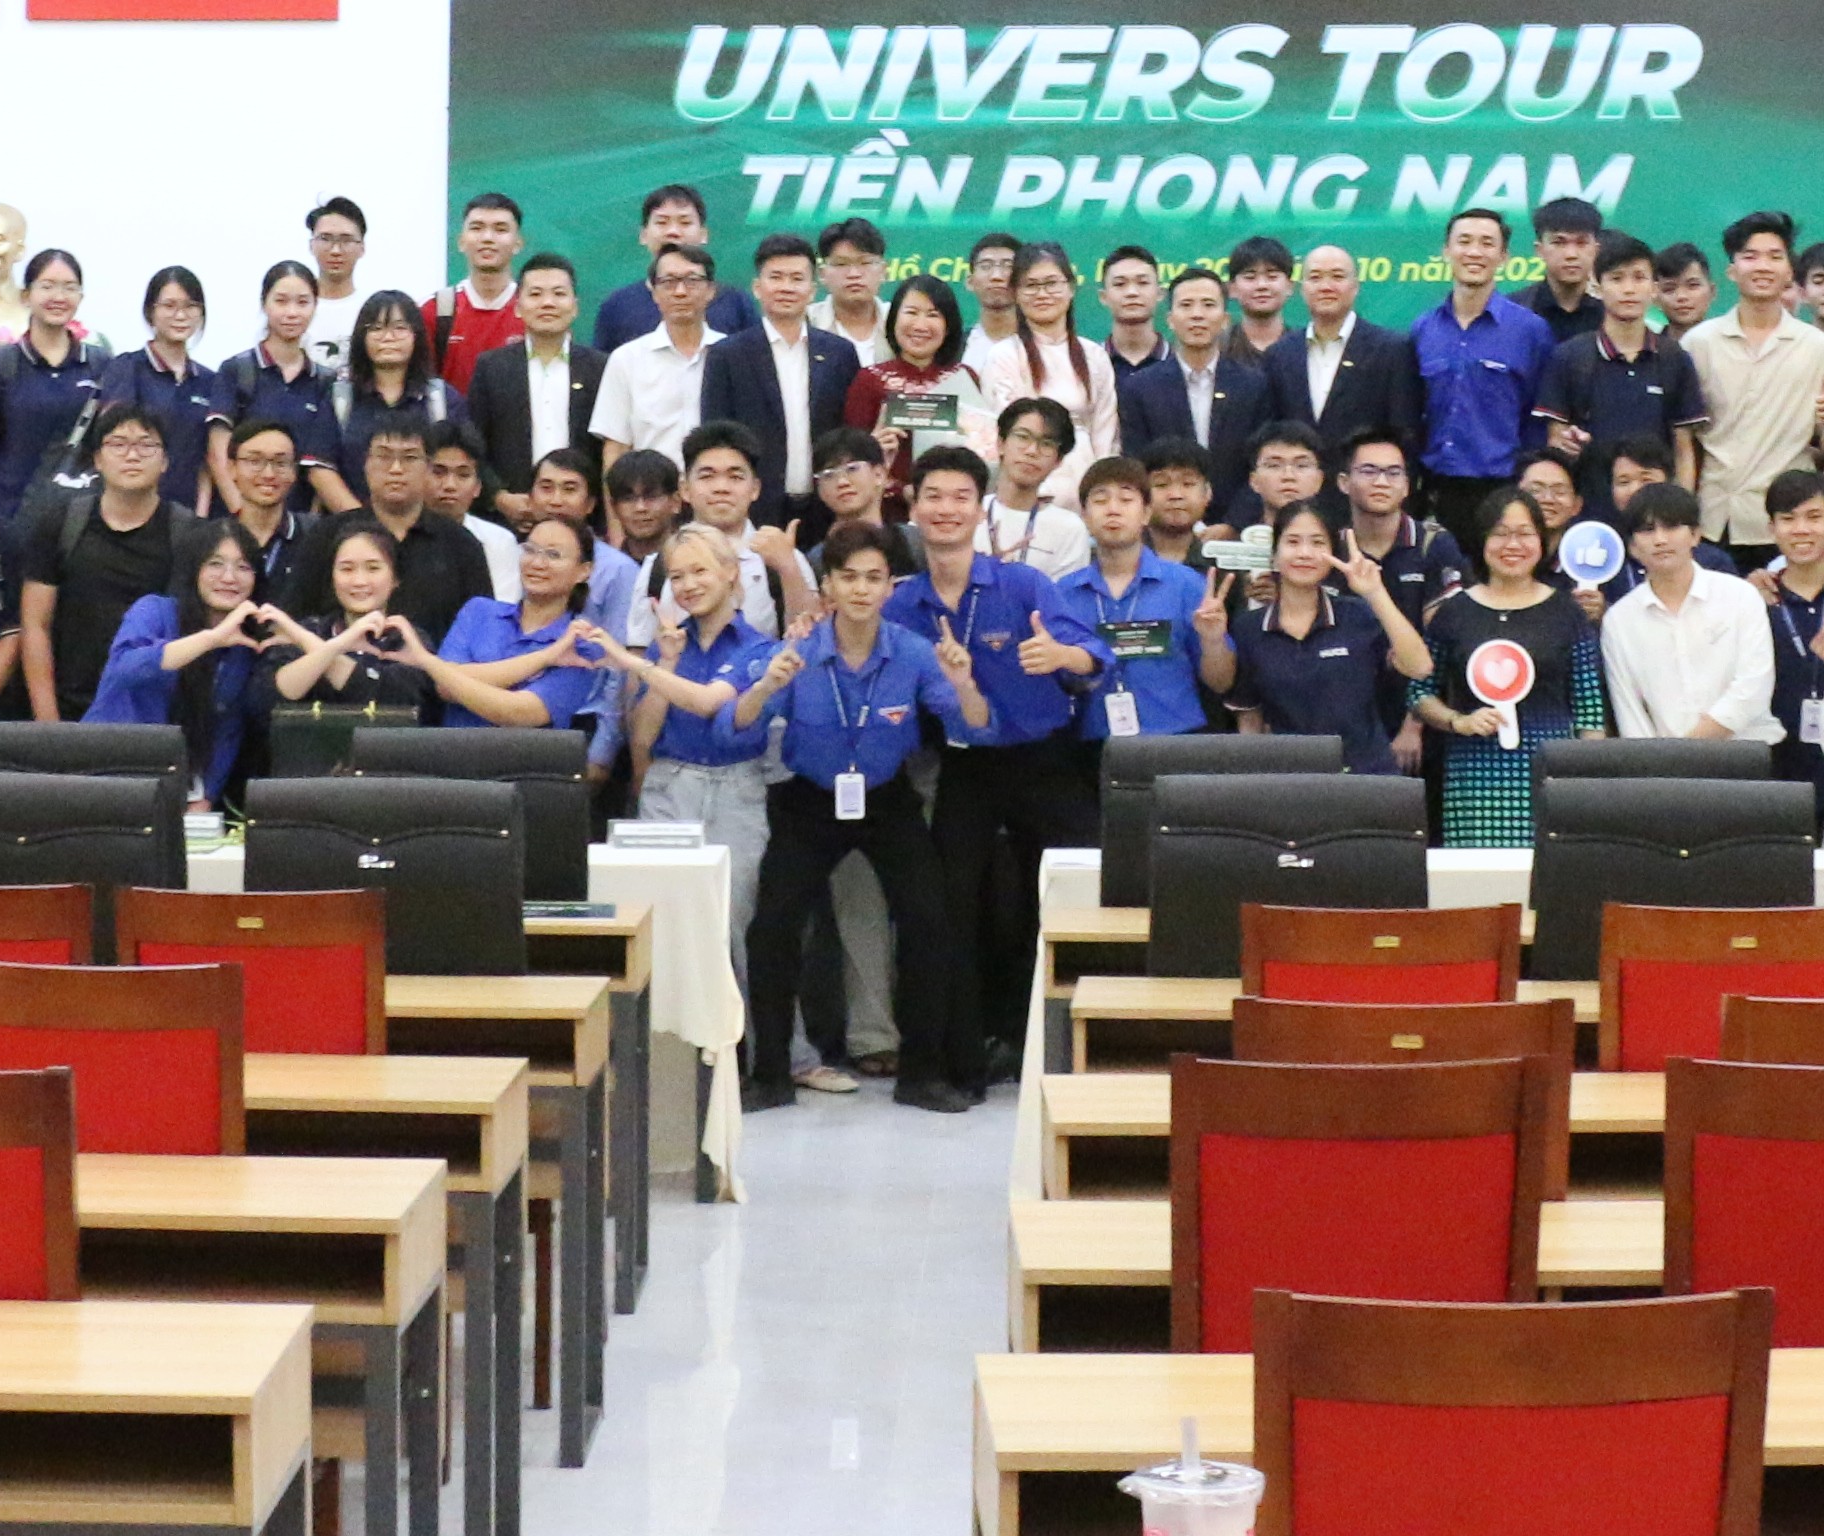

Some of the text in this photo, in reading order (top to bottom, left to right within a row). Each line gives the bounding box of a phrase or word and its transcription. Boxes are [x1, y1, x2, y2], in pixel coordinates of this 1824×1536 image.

[677, 22, 1704, 122] UNIVERS TOUR
[742, 128, 1636, 224] TIỀN PHONG NAM
